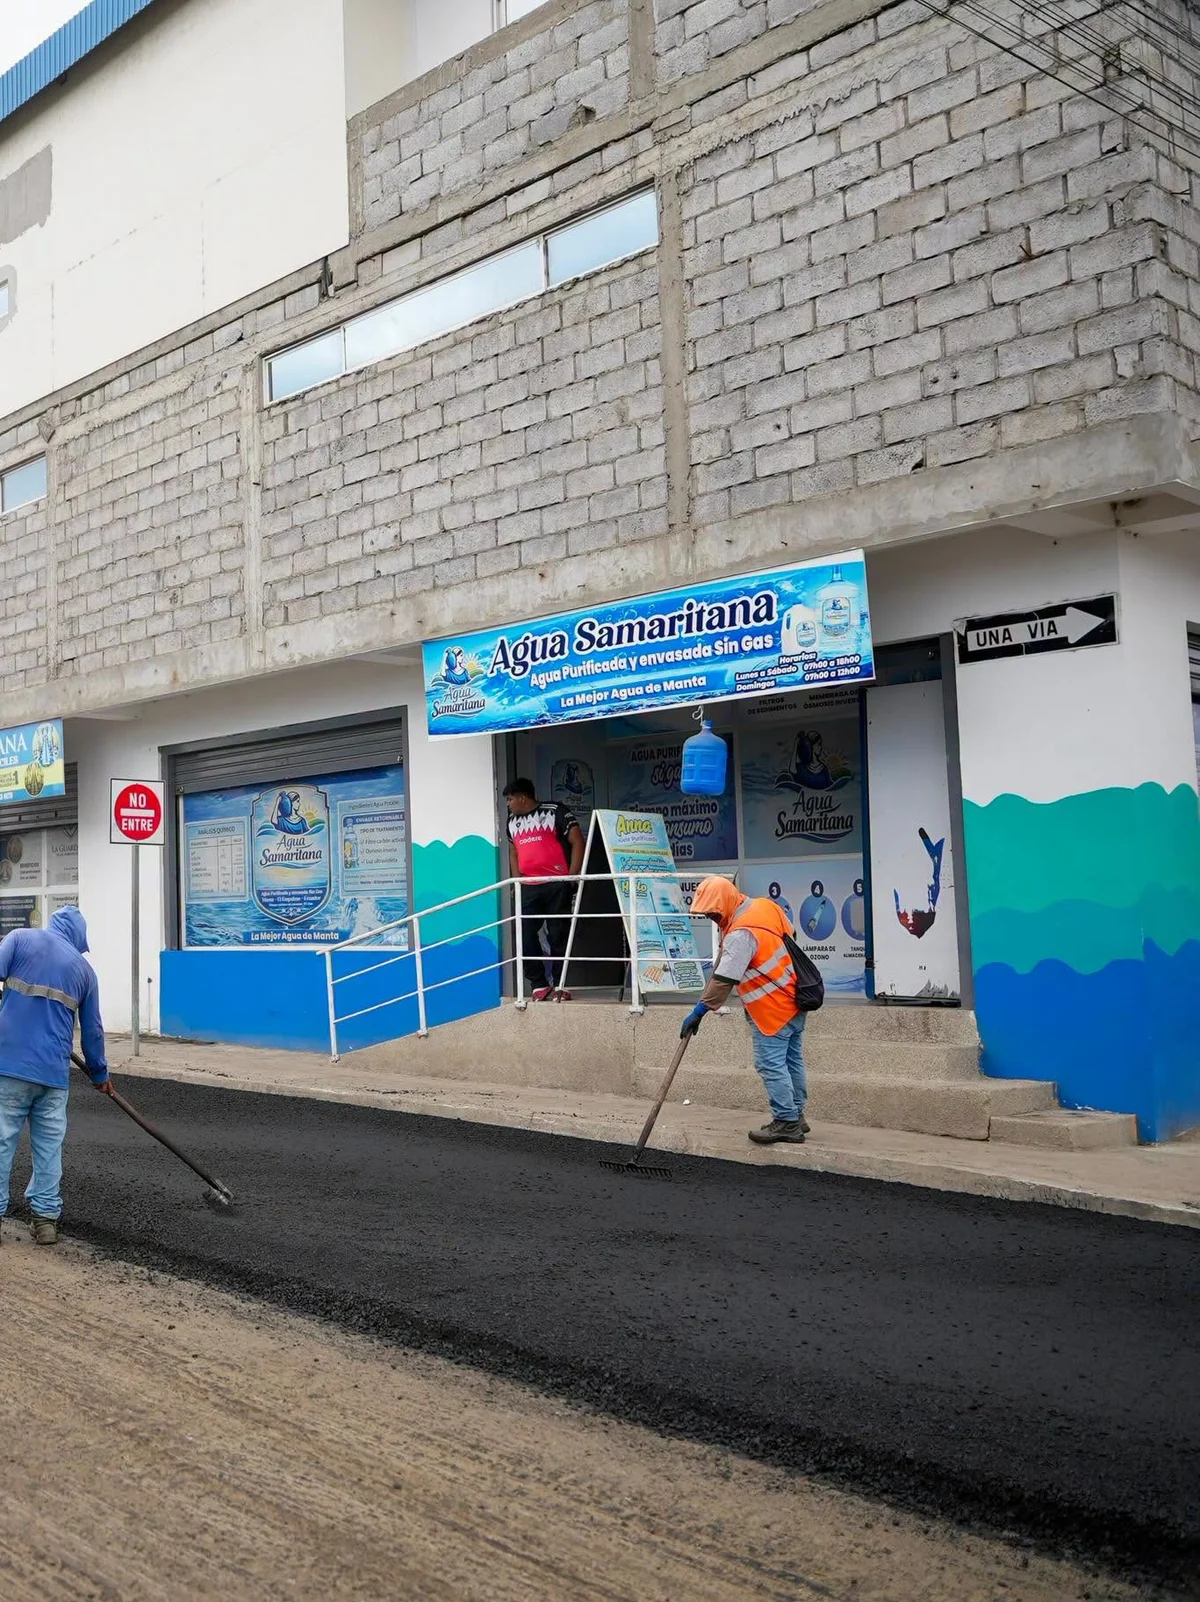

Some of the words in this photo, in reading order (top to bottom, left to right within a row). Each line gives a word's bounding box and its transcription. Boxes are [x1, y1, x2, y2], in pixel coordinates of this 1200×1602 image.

[489, 633, 567, 677] Agua
[575, 593, 775, 651] Samaritana
[976, 628, 1013, 647] UNA
[1027, 620, 1058, 639] VIA
[531, 672, 562, 689] Agua
[563, 657, 627, 680] Purificada
[628, 657, 637, 671] y
[639, 644, 712, 667] envasada
[714, 638, 738, 656] Sin
[741, 634, 774, 650] Gas
[780, 652, 816, 664] Horarios:
[804, 661, 828, 671] 07h00
[836, 656, 860, 666] 18h00
[736, 671, 758, 680] Lunes
[767, 665, 797, 676] Sábado
[804, 671, 828, 681] 07h00
[837, 666, 860, 676] 12h00
[561, 697, 574, 708] La
[575, 690, 609, 706] Mejor
[611, 685, 644, 700] Agua
[646, 682, 661, 693] de
[663, 676, 707, 692] Manta
[736, 680, 775, 692] Domingos
[443, 686, 472, 703] Agua
[432, 698, 485, 718] Samaritana
[631, 750, 655, 763] AGUA
[129, 792, 147, 808] NO
[670, 799, 718, 817] máximo
[792, 791, 834, 817] Agua
[121, 818, 153, 831] ENTRE
[617, 815, 652, 836] Anna
[775, 811, 854, 837] Samaritana
[276, 835, 308, 851] Agua
[519, 835, 543, 845] codere
[260, 848, 322, 866] Samaritana
[251, 933, 260, 941] La
[260, 932, 281, 942] Mejor
[281, 932, 302, 942] Agua
[303, 932, 312, 940] de
[313, 931, 339, 940] Manta
